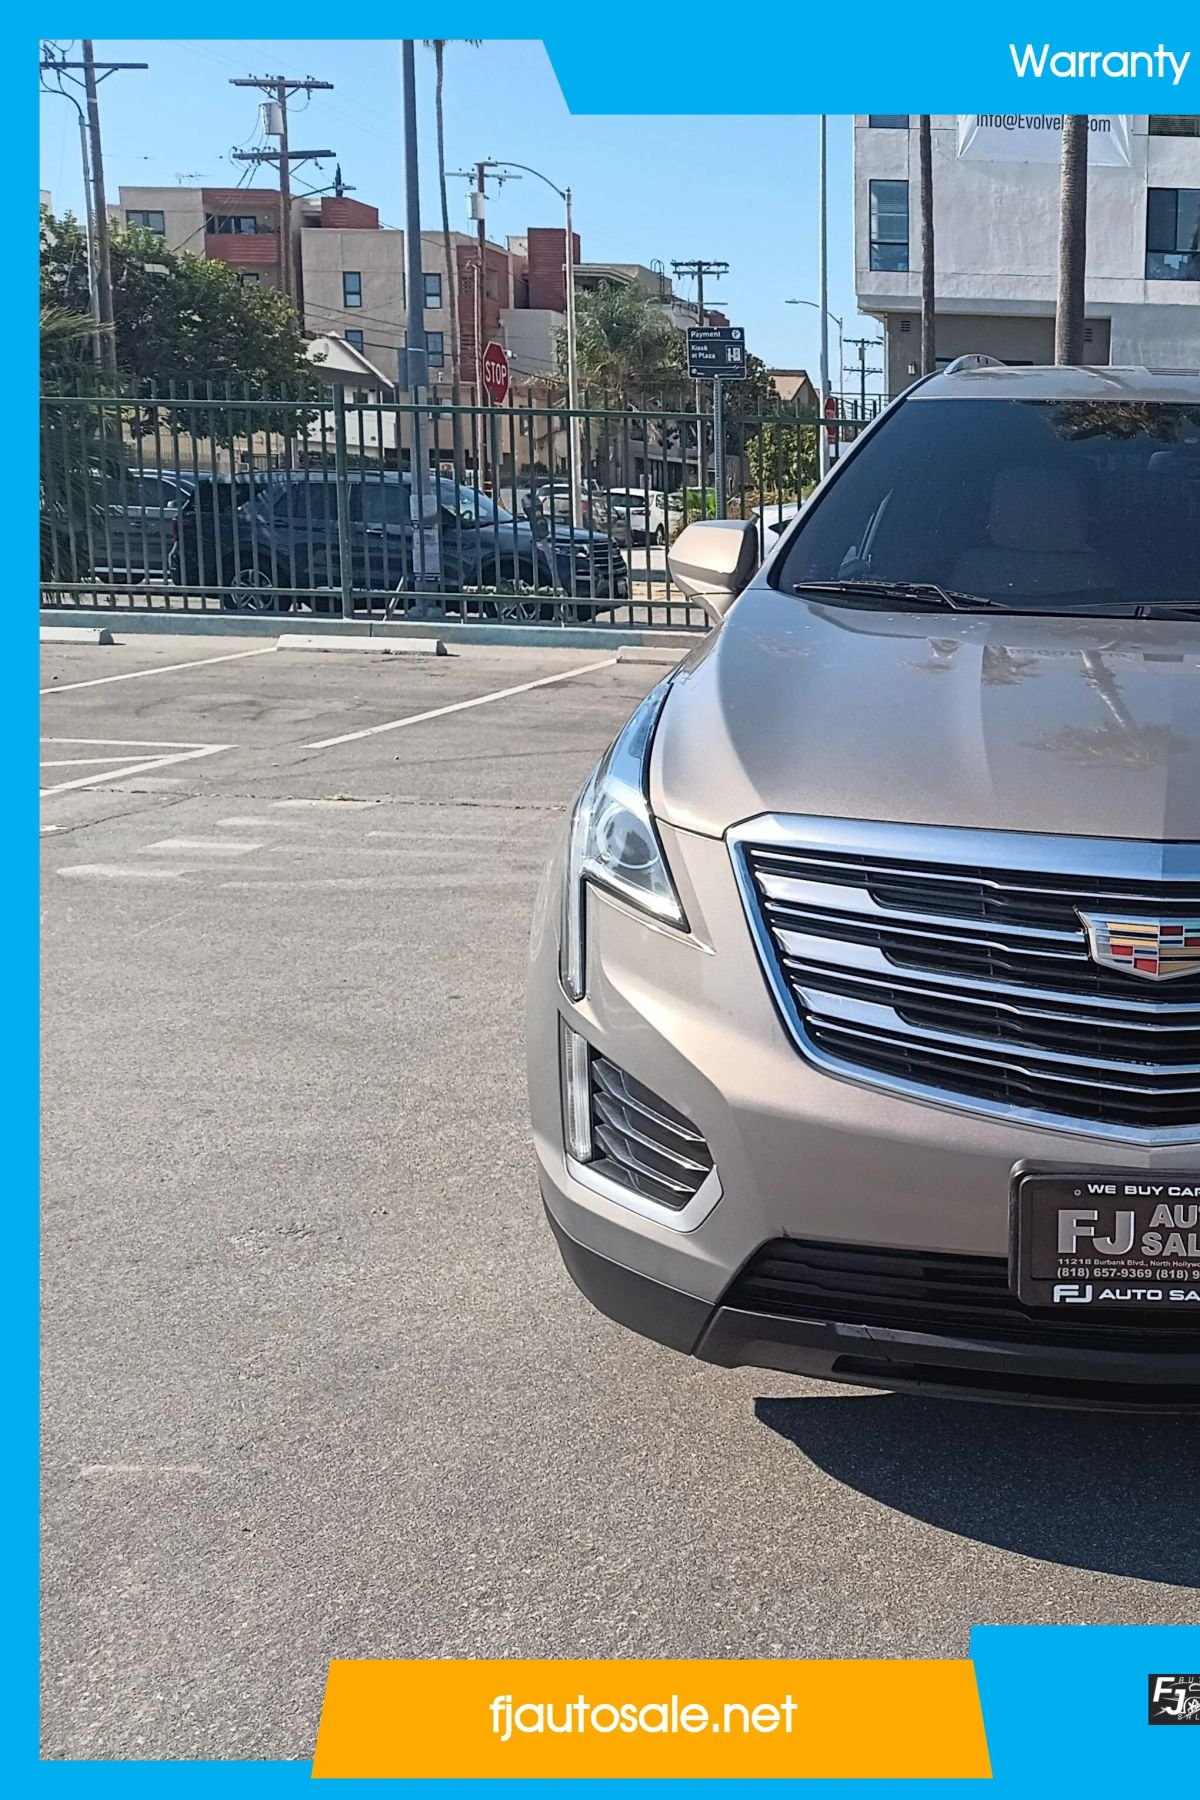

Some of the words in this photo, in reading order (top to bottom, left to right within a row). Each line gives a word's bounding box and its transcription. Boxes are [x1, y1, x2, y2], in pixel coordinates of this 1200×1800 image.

[691, 331, 721, 339] Payment
[485, 360, 507, 385] STOP
[1087, 1184, 1116, 1194] WE
[1124, 1185, 1164, 1196] BUY
[1057, 1209, 1135, 1255] FJ
[1093, 1258, 1125, 1266] Burbank
[1057, 1267, 1090, 1279] (818)
[1093, 1268, 1152, 1278] 657-9369
[1156, 1269, 1188, 1281] (818)
[1053, 1284, 1093, 1303] FJ
[1098, 1288, 1163, 1301] AUTO
